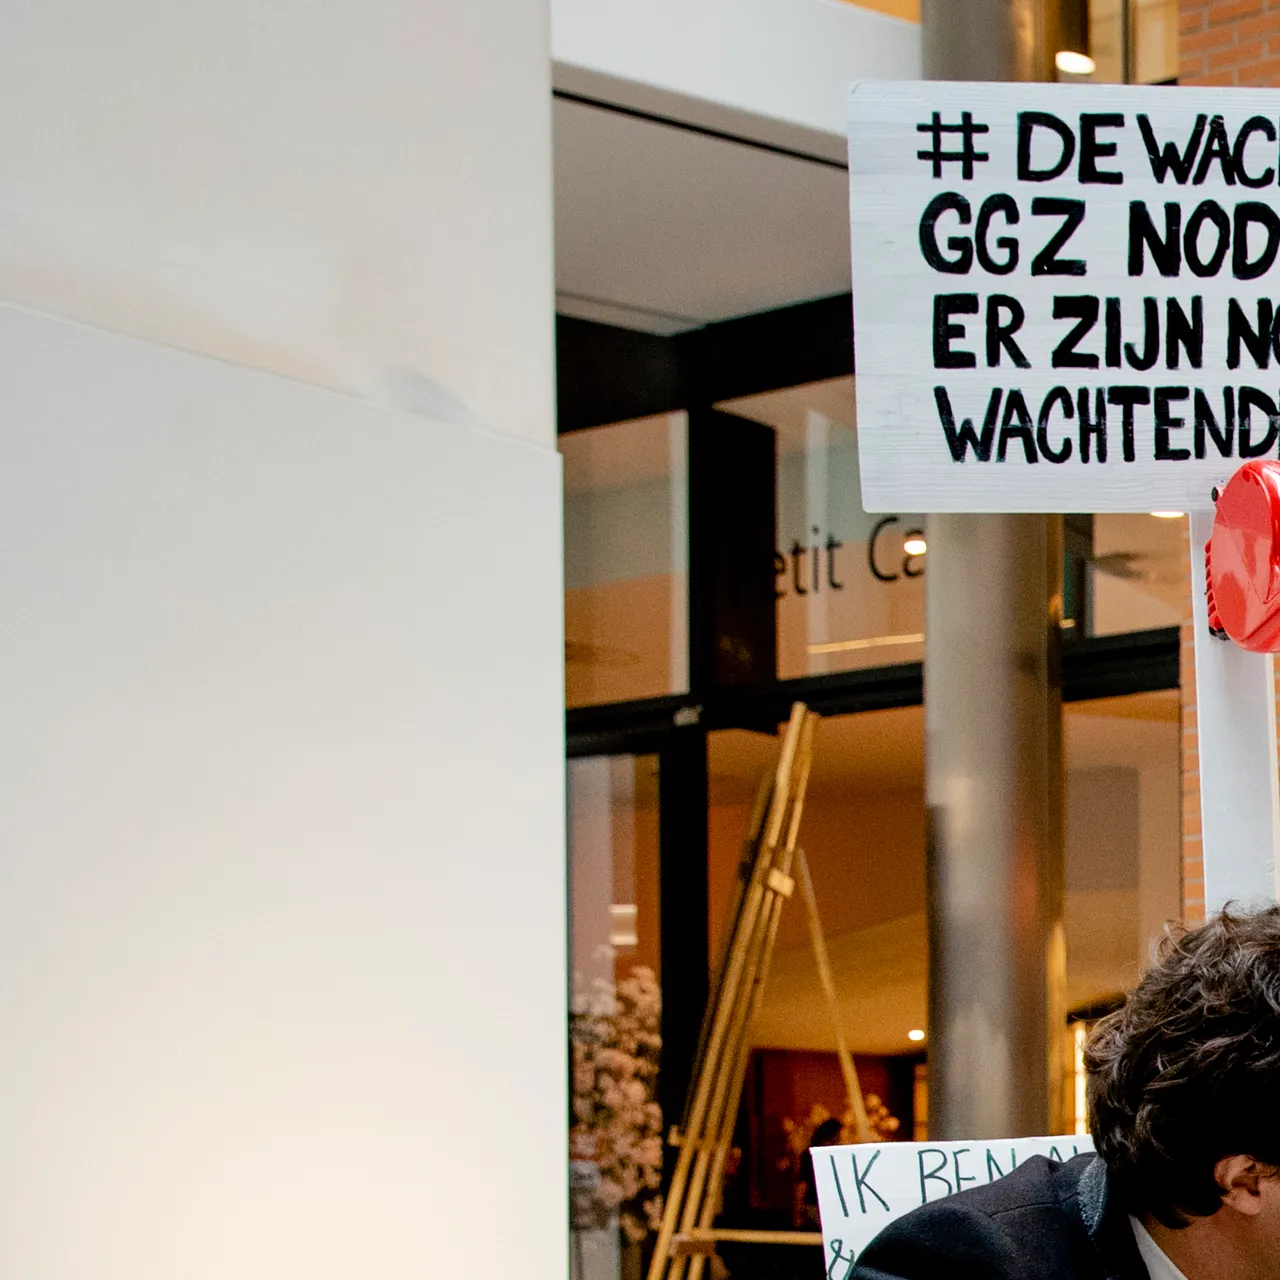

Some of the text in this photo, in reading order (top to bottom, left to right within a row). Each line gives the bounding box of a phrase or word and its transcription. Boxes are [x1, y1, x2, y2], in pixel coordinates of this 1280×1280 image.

[1017, 112, 1124, 184] DE
[919, 192, 1087, 276] GGZ
[933, 293, 1031, 369] ER
[1052, 295, 1203, 371] ZIJN
[830, 1147, 1017, 1217] IK BEN
